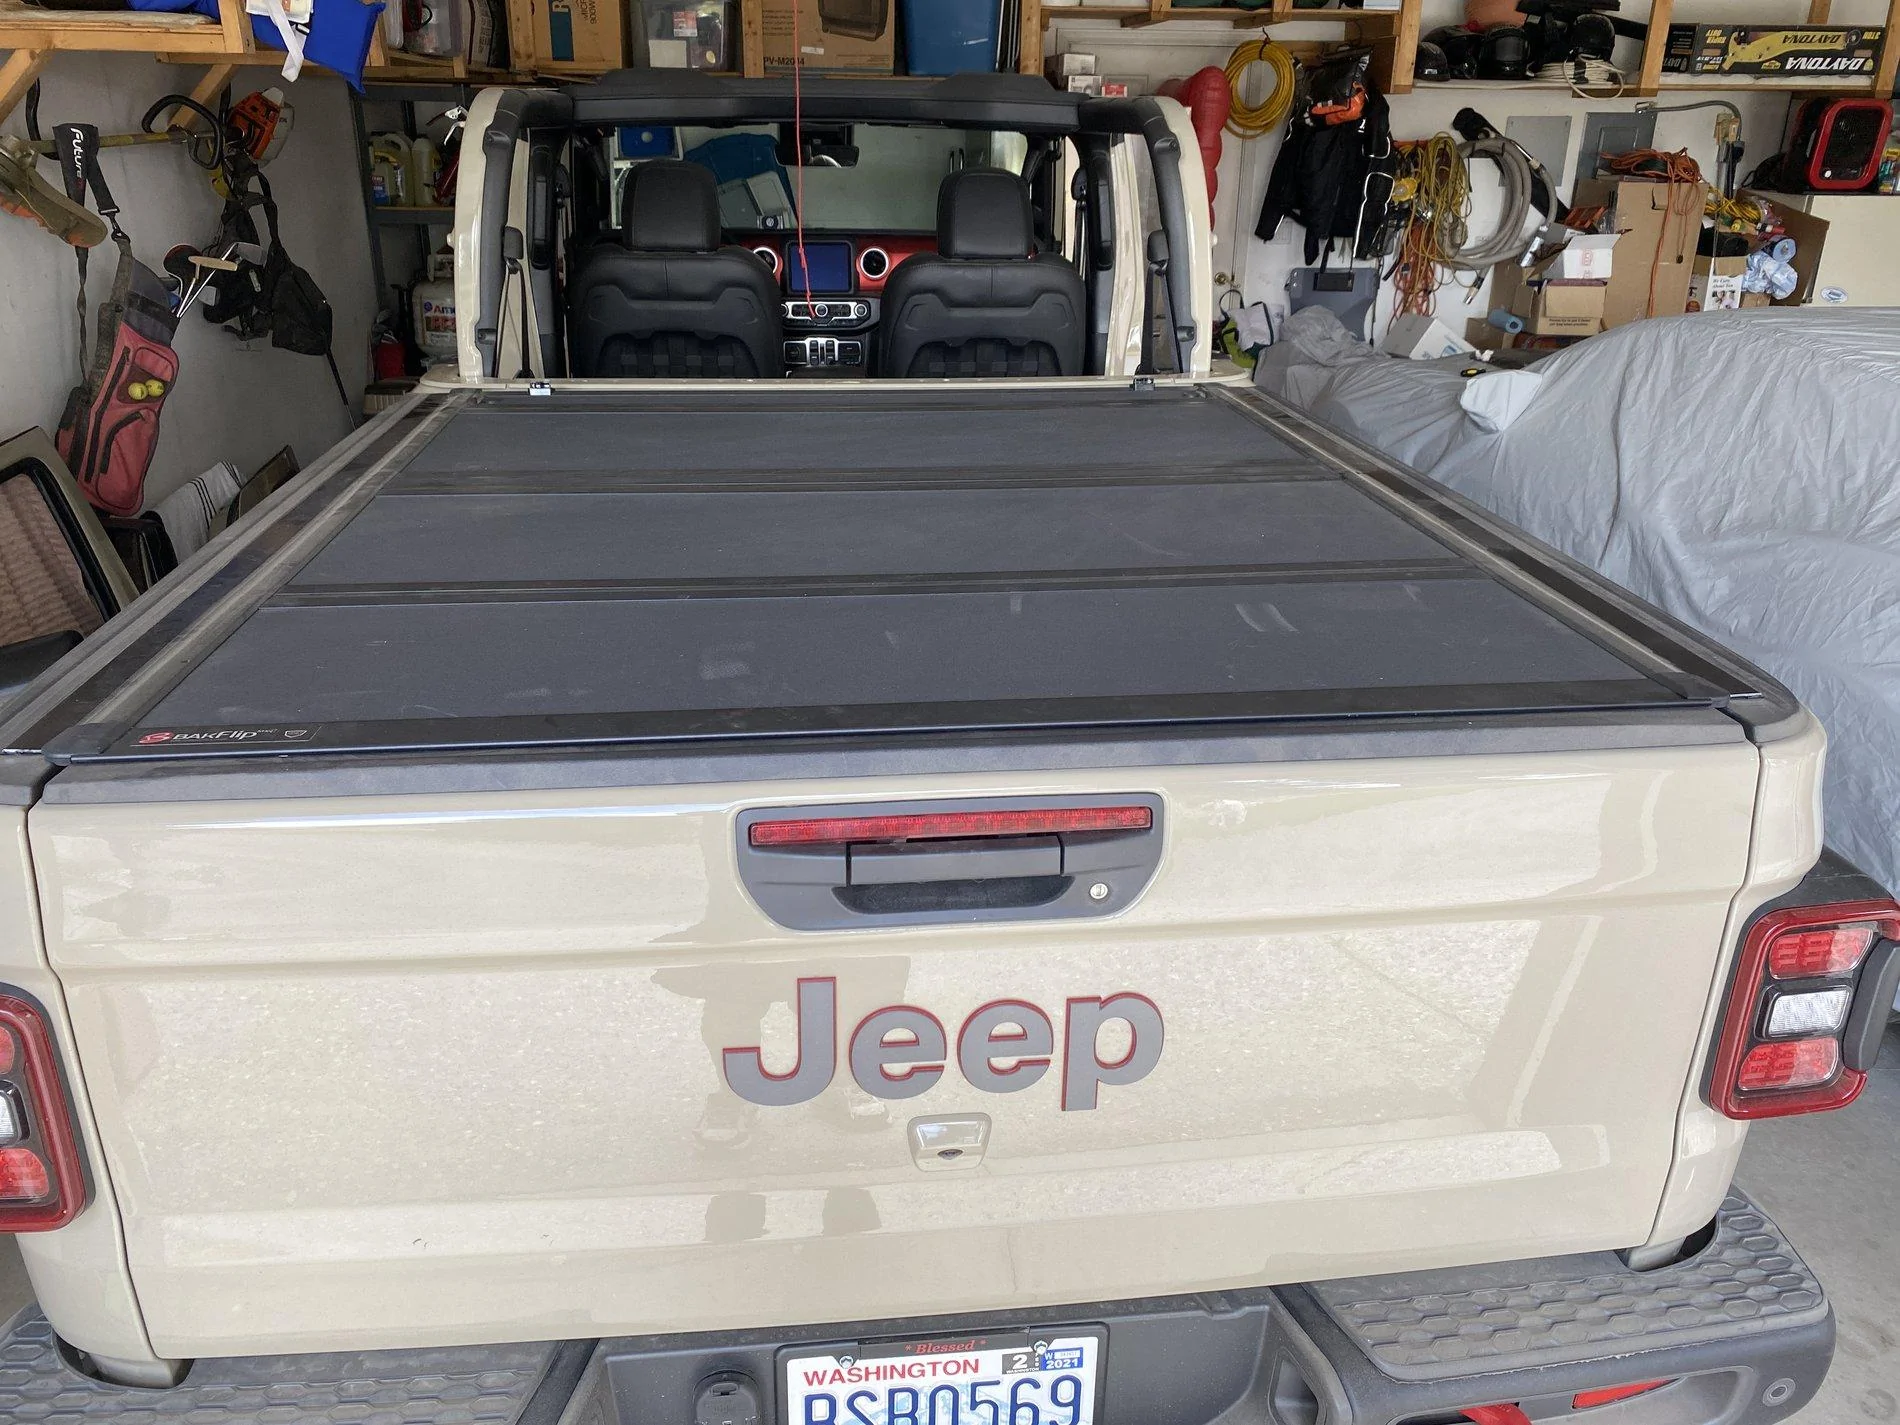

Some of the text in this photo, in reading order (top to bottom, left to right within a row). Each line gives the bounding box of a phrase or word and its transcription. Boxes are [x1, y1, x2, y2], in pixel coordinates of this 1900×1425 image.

[1782, 34, 1841, 44] DAYTONA
[1785, 57, 1866, 70] DAYTONA
[173, 729, 258, 741] BAKFlip
[722, 976, 1165, 1111] Jeep
[914, 1339, 976, 1354] Blessed
[1012, 1353, 1028, 1370] 2
[1045, 1358, 1078, 1370] 2021
[803, 1358, 980, 1387] WASHINGTON
